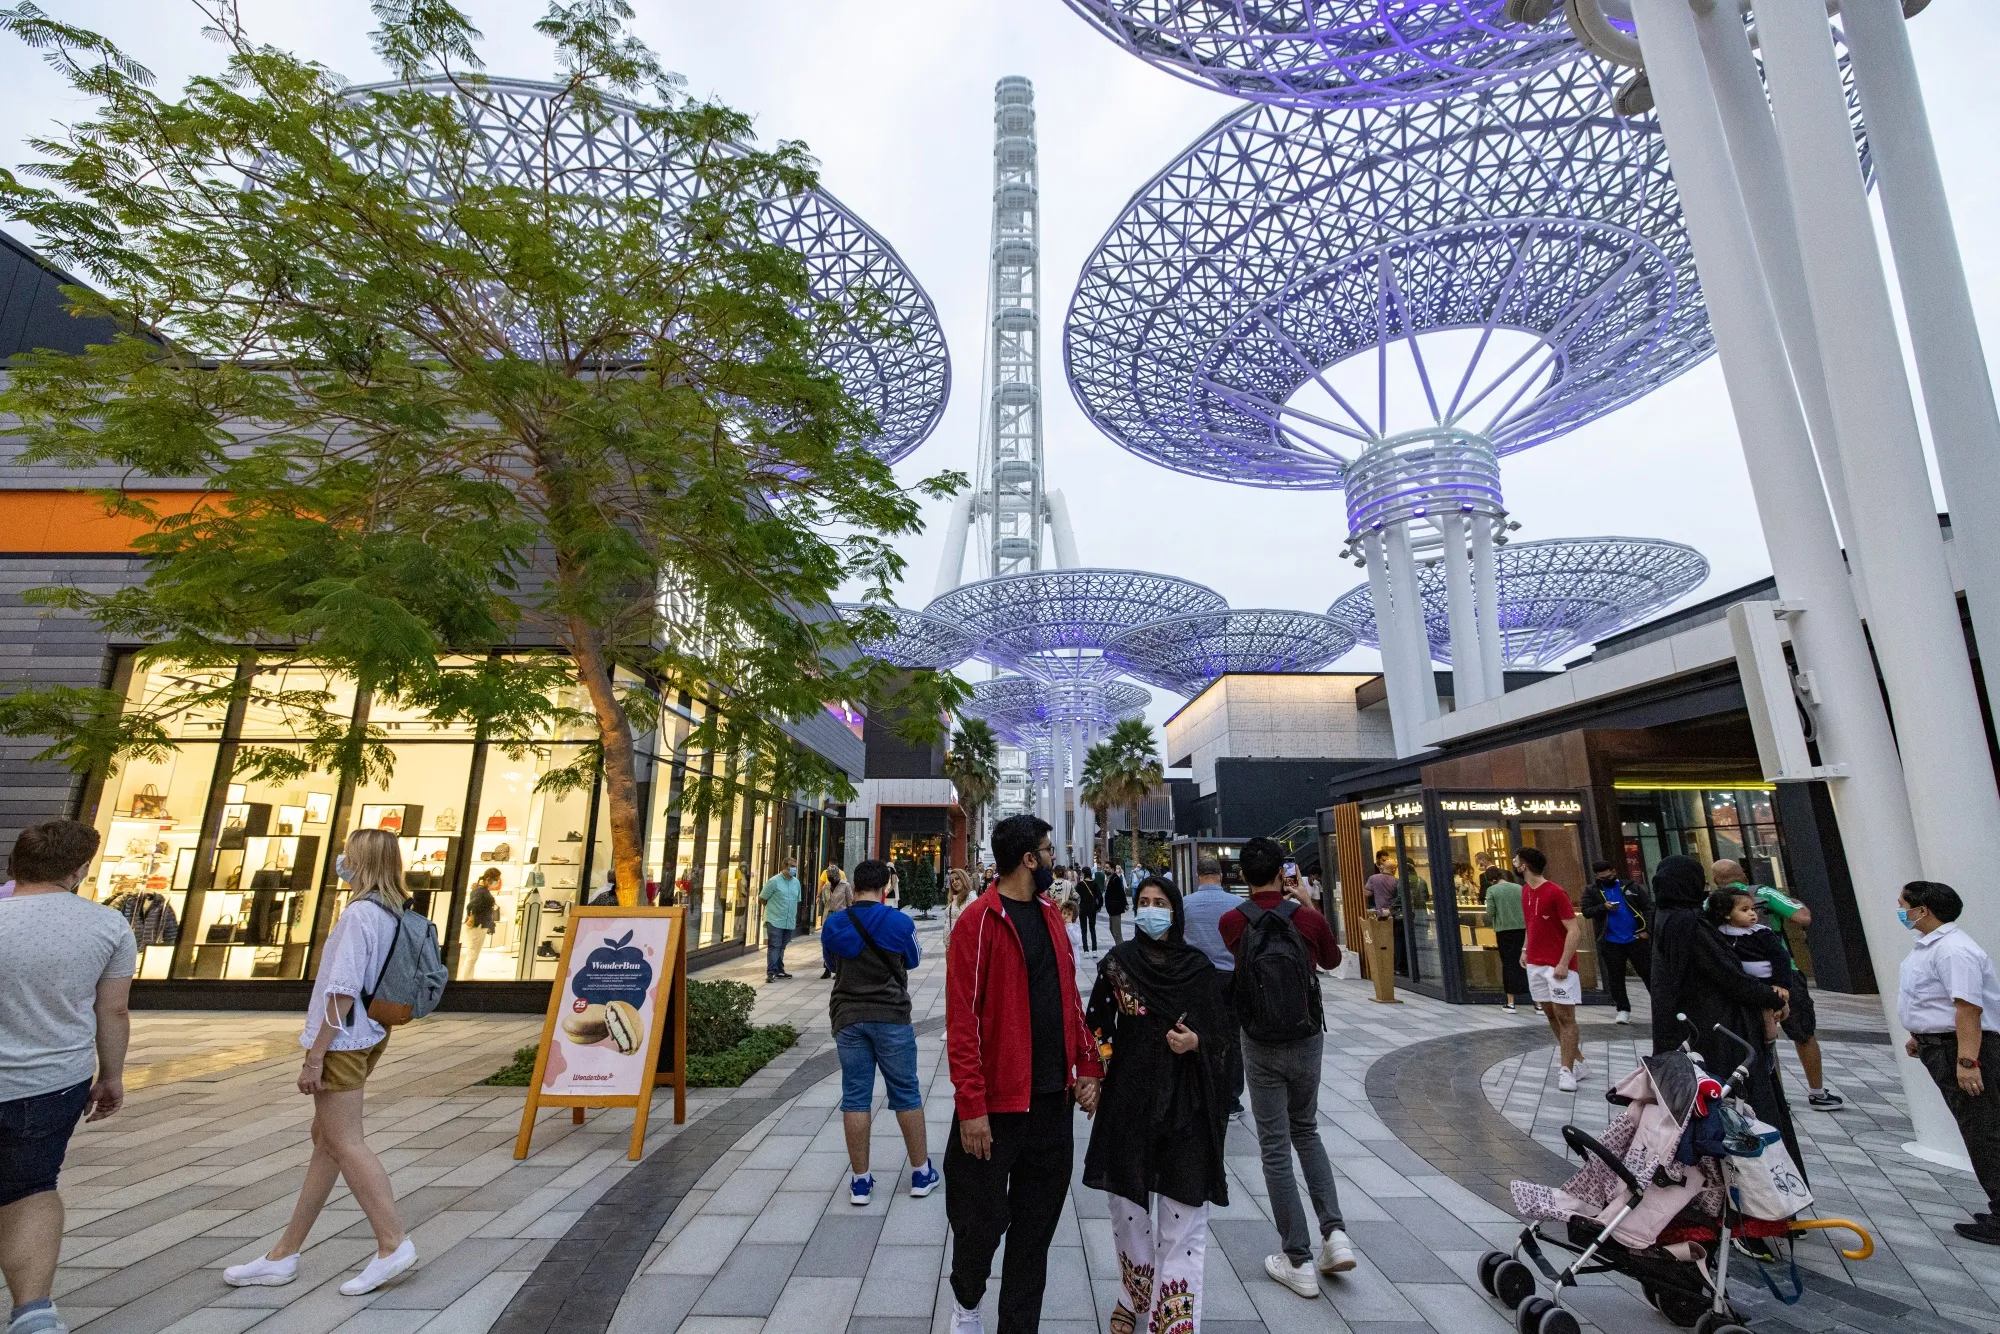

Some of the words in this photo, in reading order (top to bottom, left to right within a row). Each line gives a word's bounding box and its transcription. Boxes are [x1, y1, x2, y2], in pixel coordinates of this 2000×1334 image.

[1459, 802, 1468, 810] Al
[1470, 802, 1499, 811] Emarat
[592, 961, 640, 970] WonderBun
[575, 1000, 586, 1008] 25
